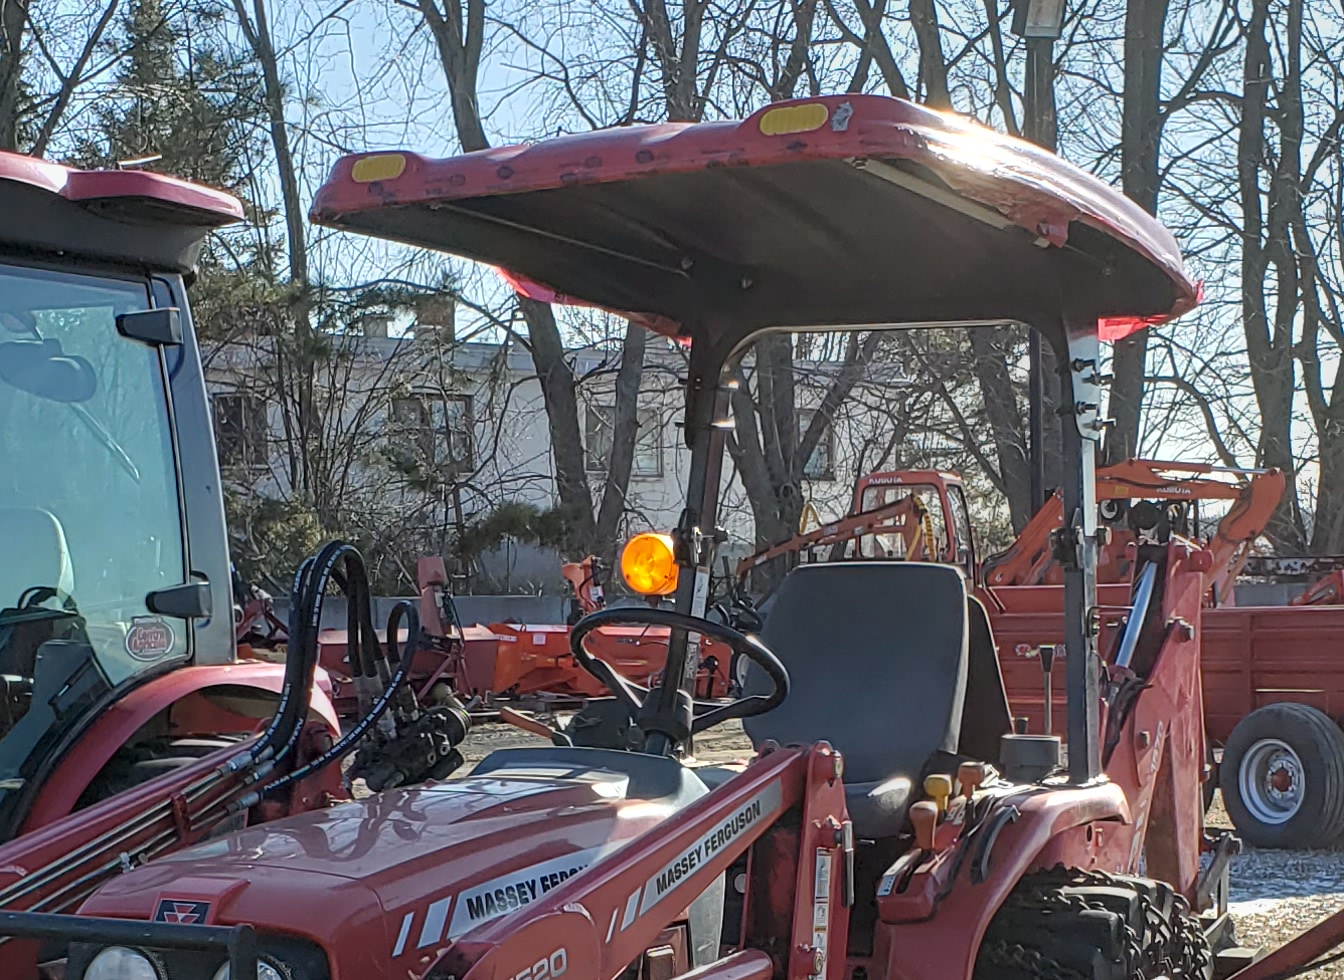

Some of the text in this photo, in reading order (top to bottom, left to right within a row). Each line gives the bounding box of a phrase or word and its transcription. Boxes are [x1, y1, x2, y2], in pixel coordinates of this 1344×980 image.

[656, 800, 762, 895] MASSEY FERGUSON
[466, 879, 537, 920] MASSEY
